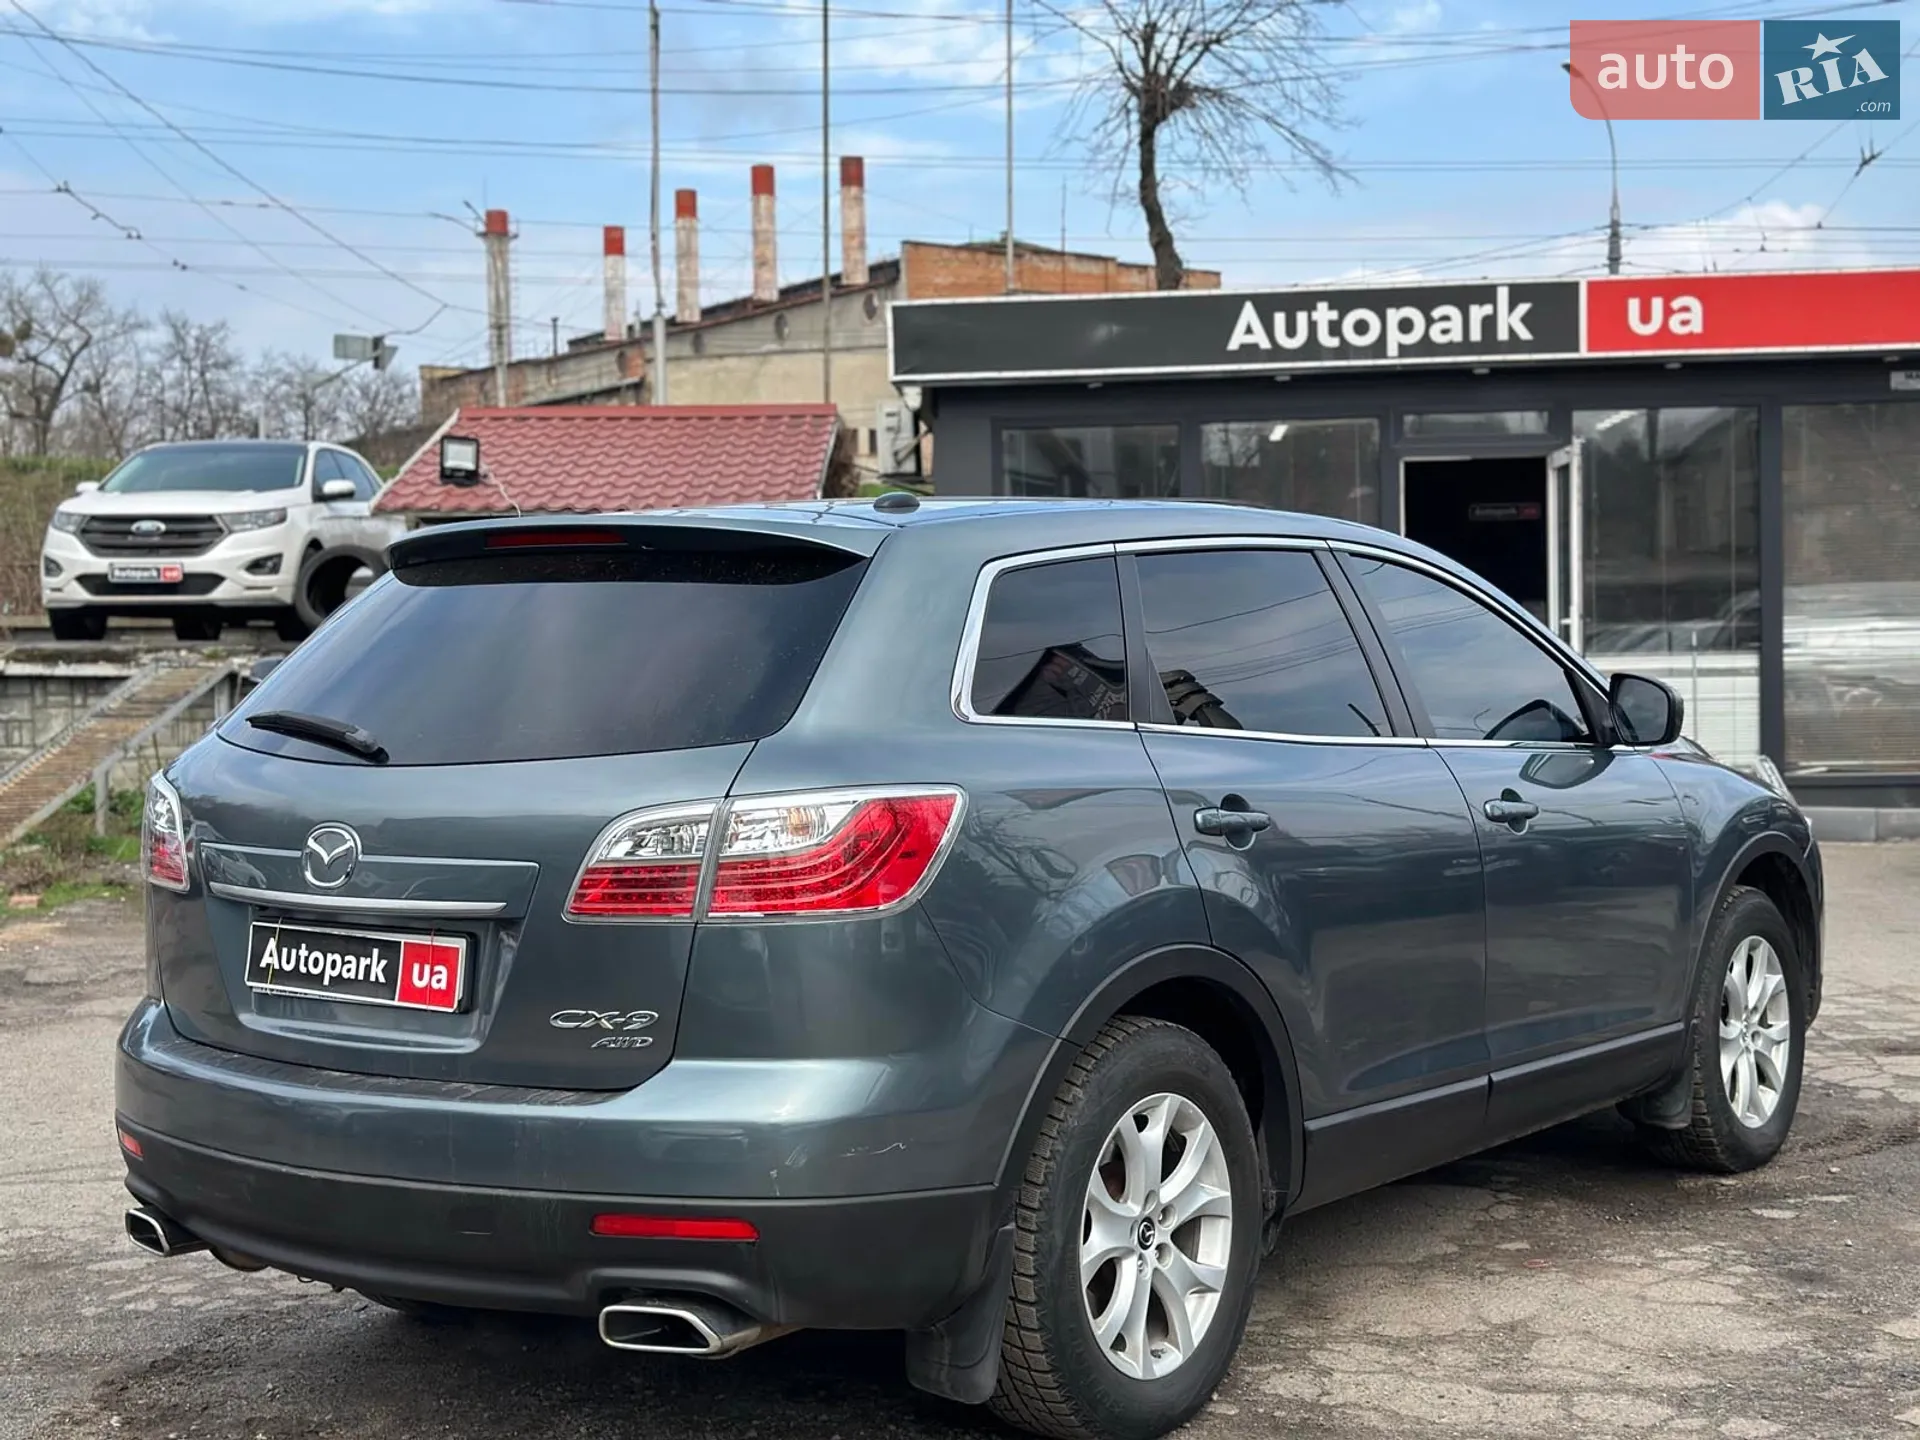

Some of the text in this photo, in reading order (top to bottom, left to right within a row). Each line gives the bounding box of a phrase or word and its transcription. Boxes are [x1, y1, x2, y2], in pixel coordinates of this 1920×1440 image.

[1226, 286, 1704, 357] Autopark ua
[259, 937, 448, 990] Autopark ua
[549, 1009, 659, 1030] CX-9
[590, 1036, 653, 1048] AWD
